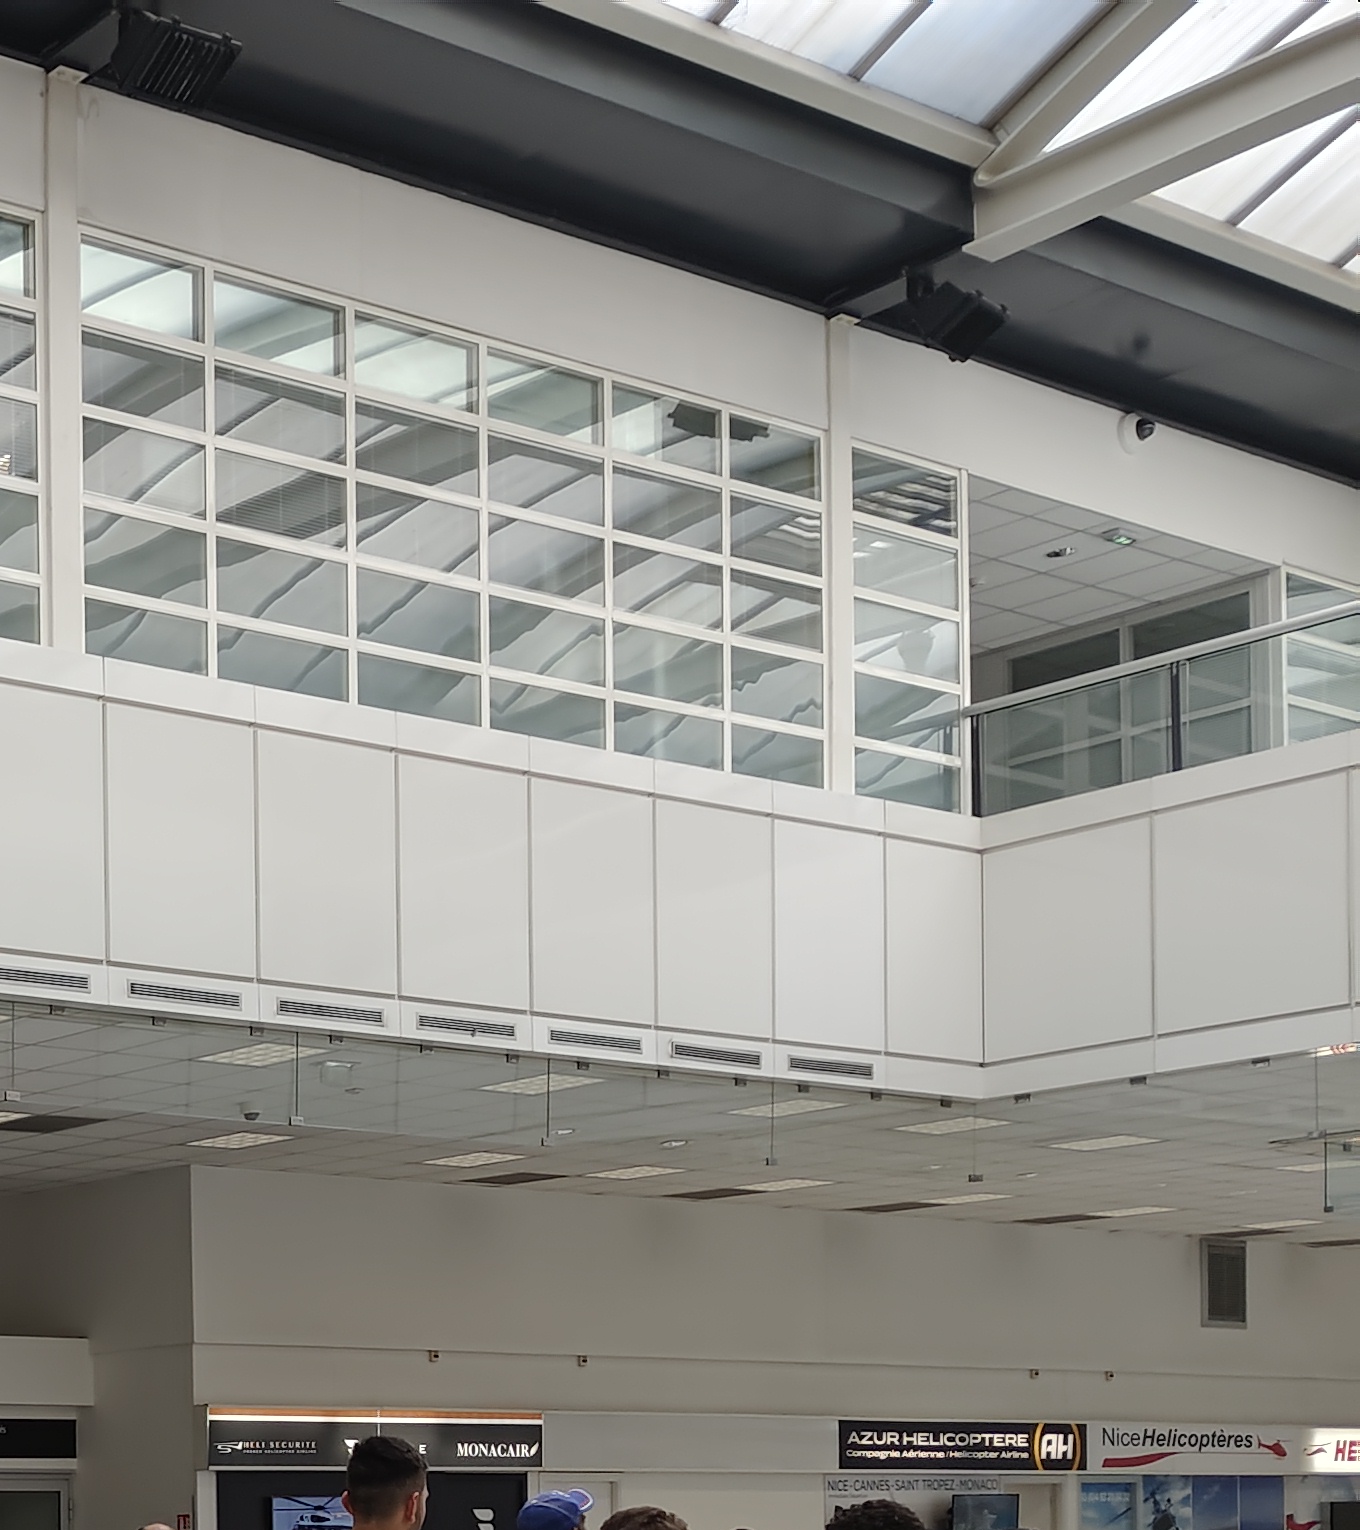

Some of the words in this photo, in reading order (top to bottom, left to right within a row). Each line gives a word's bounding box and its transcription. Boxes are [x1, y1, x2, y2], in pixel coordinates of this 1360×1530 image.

[847, 1431, 899, 1445] AZUR
[902, 1433, 1029, 1447] HELICOPTERE
[457, 1443, 530, 1457] MONACAIR
[846, 1450, 901, 1460] Compagnie
[902, 1449, 945, 1459] Aérienne
[950, 1450, 999, 1460] Helicopter
[1000, 1450, 1029, 1459] Airline
